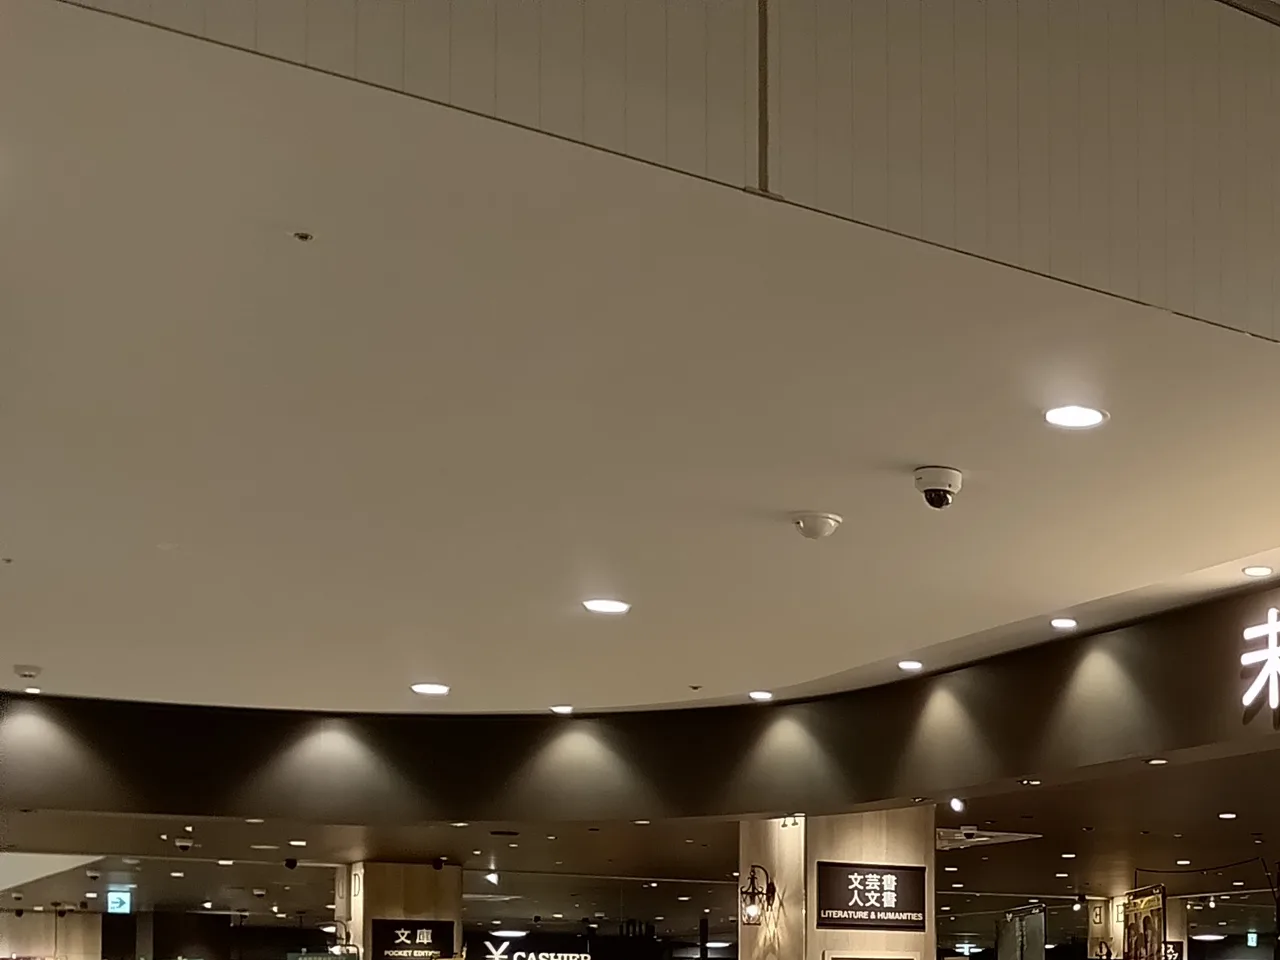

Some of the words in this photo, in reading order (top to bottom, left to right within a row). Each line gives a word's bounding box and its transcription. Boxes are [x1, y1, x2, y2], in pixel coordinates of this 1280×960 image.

[848, 872, 897, 891] 文芸書
[848, 891, 897, 908] 人文書
[820, 910, 869, 920] LITERATURE
[870, 912, 876, 920] &
[876, 912, 923, 921] HUMANITIES
[394, 928, 433, 945] 文庫
